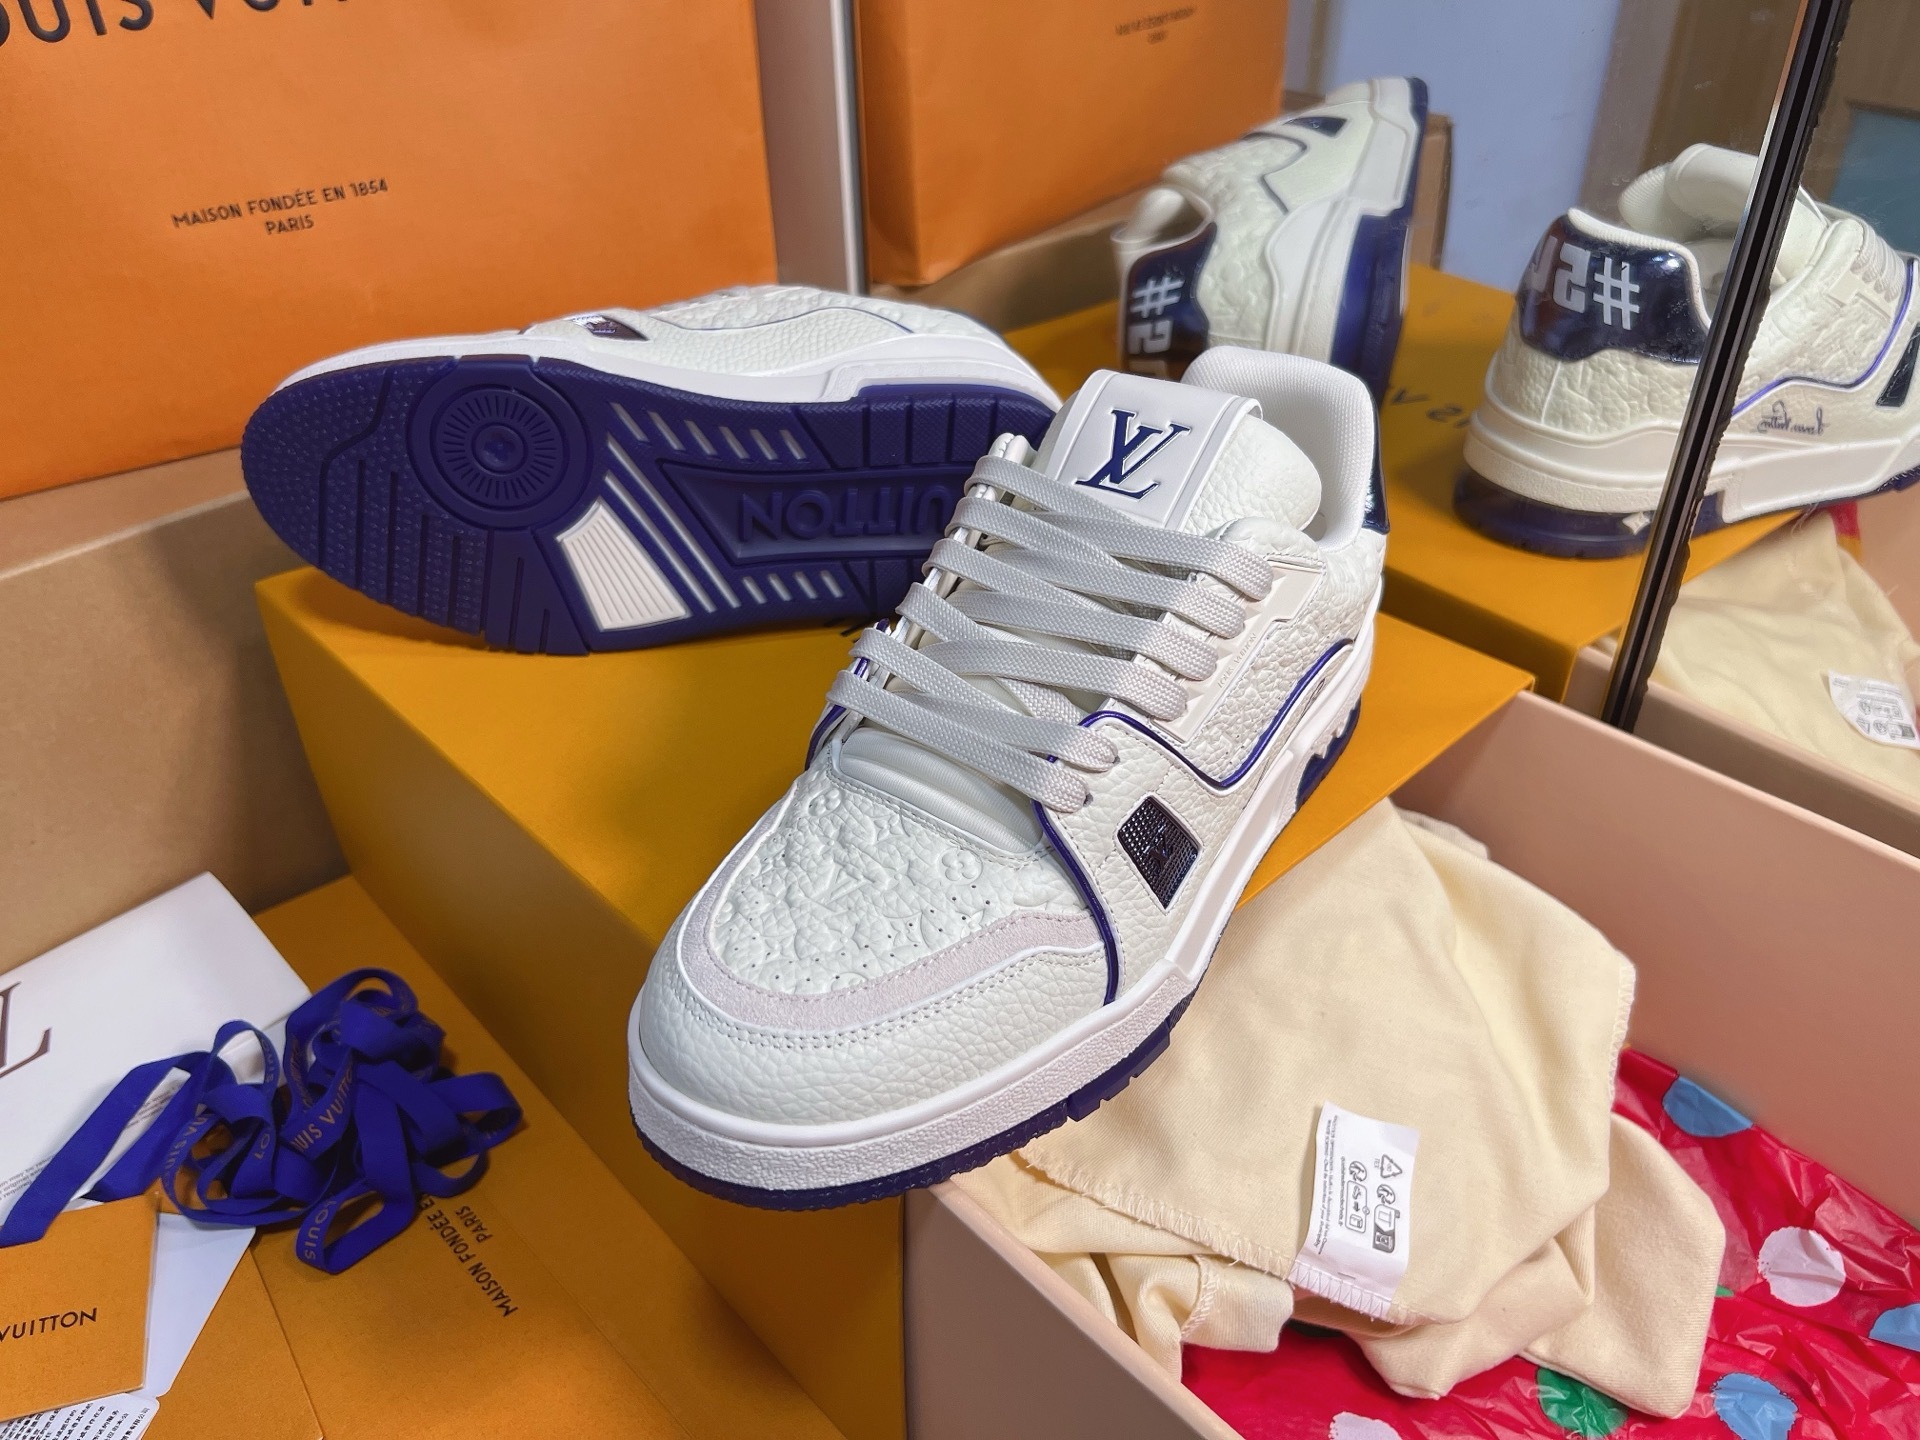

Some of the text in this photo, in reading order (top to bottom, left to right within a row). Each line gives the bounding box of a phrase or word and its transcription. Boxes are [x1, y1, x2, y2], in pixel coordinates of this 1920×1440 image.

[172, 177, 389, 229] MAISON FONDÉE EN 1854
[264, 214, 315, 235] PARIS
[1073, 408, 1191, 500] LV
[738, 485, 953, 542] UITTON
[422, 1209, 470, 1263] FONDÉE
[455, 1205, 492, 1244] PARIS
[468, 1262, 518, 1317] MAISON
